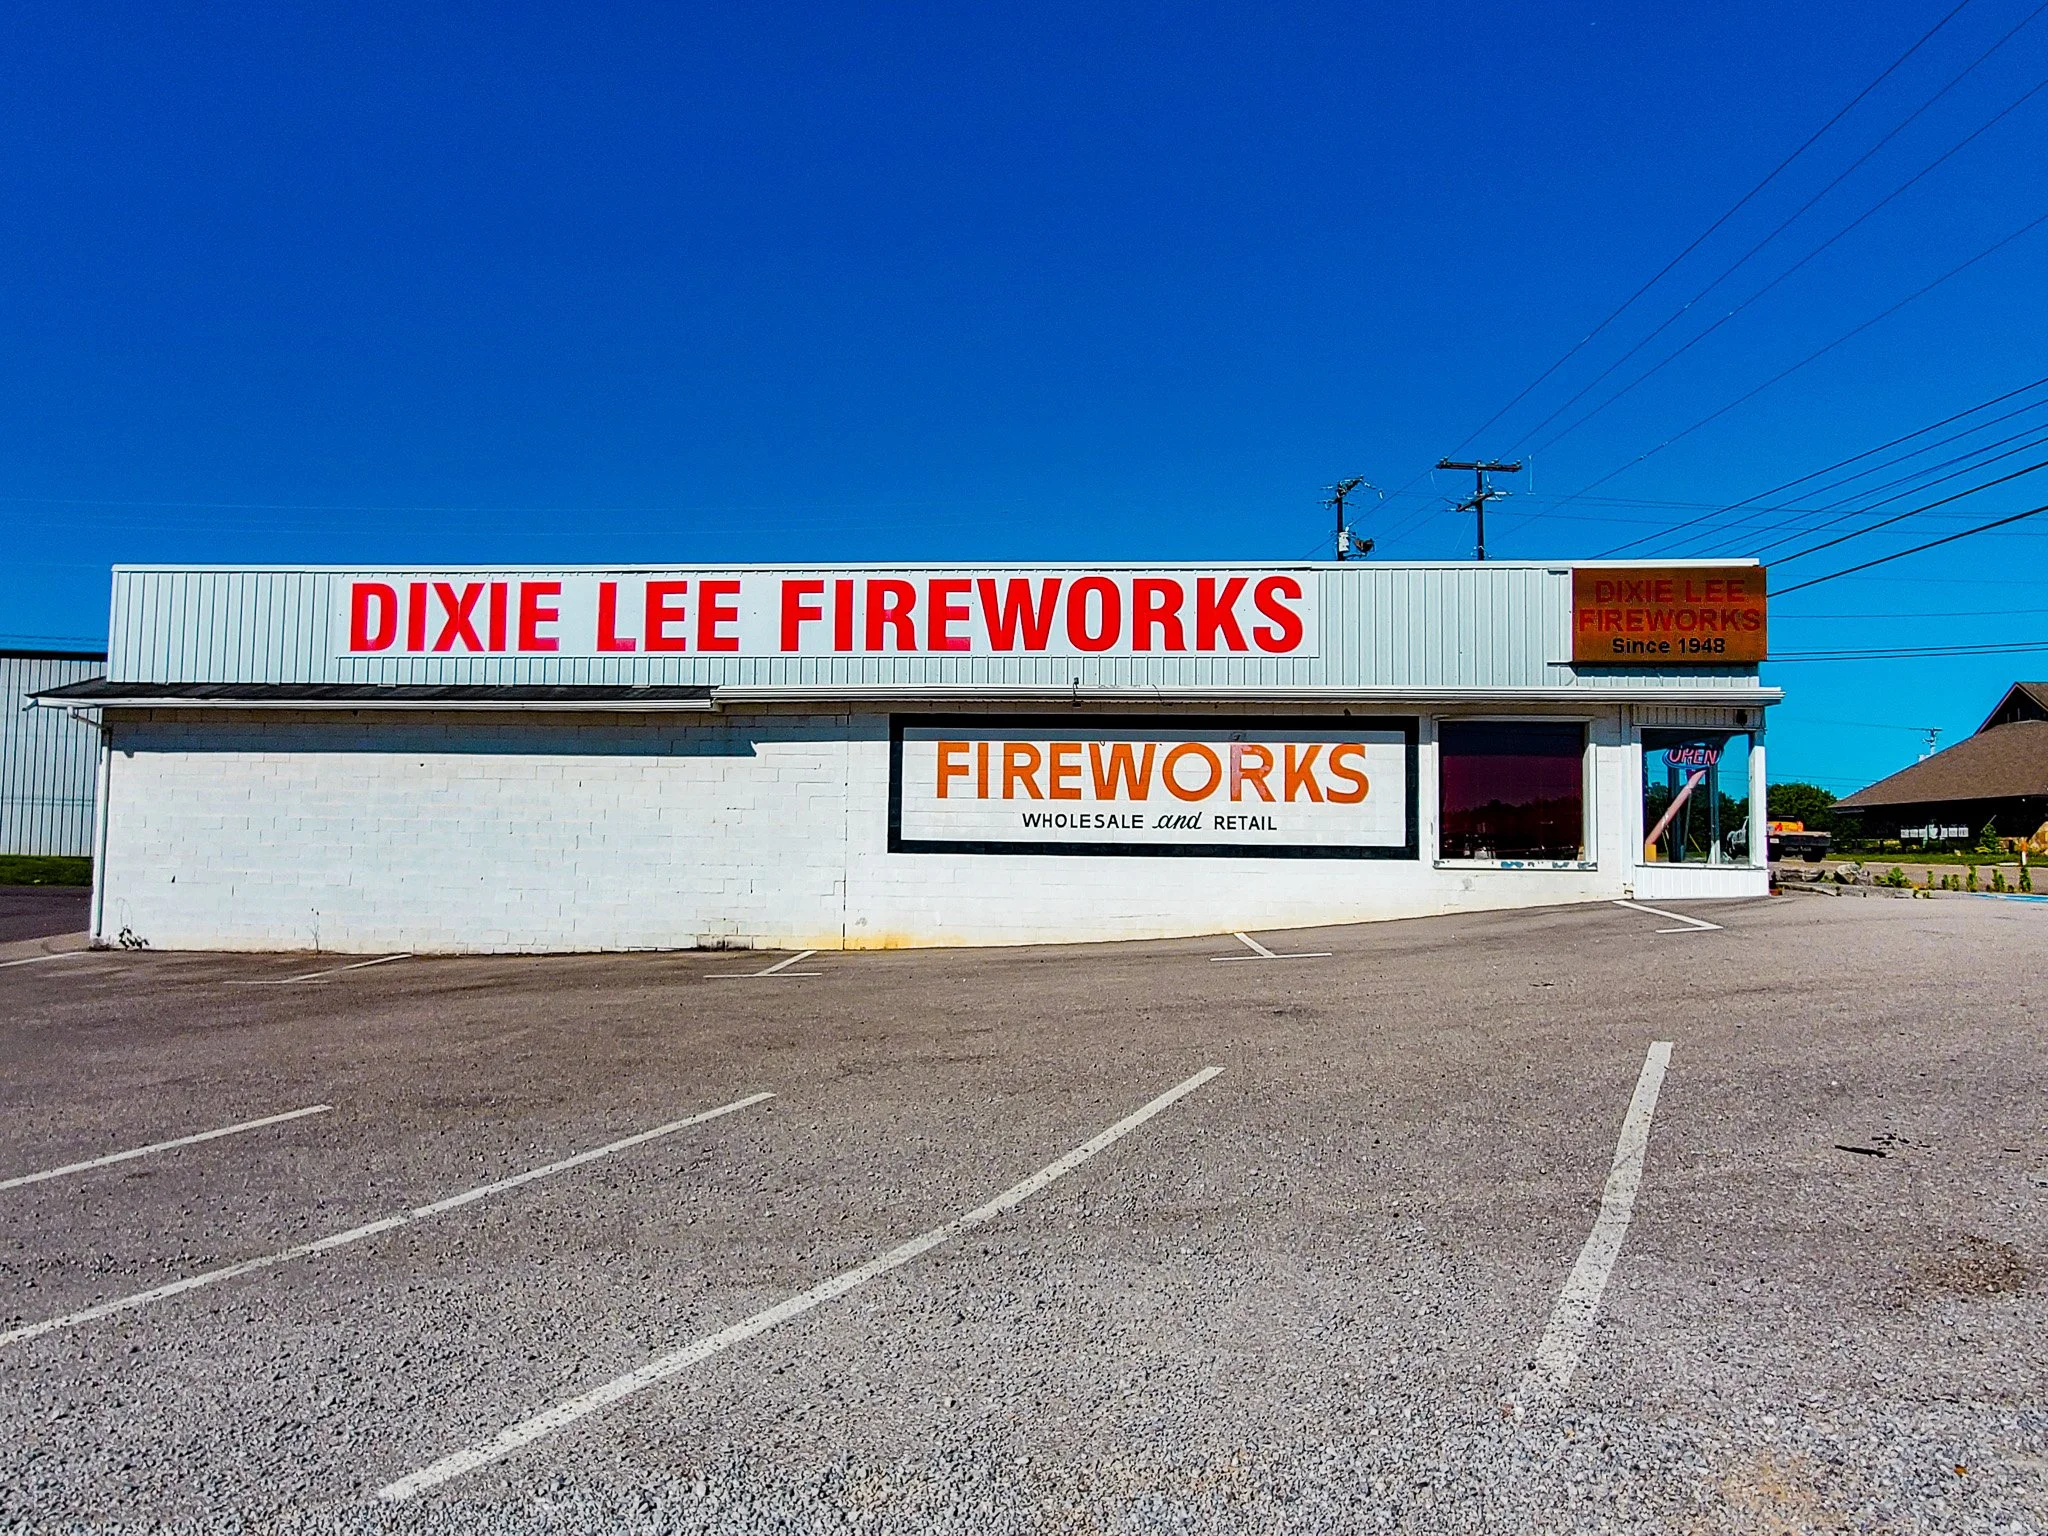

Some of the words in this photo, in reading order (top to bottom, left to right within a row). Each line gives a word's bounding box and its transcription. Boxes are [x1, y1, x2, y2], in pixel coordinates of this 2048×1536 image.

[1595, 579, 1673, 603] DIXIE
[1686, 579, 1746, 603] LEE
[350, 582, 561, 652] DIXIE
[597, 581, 740, 652] LEE
[780, 576, 1303, 654] FIREWORKS
[1579, 608, 1762, 633] FIREWORKS
[1612, 637, 1671, 654] Since
[1678, 637, 1726, 654] 1948
[1669, 748, 1718, 764] OPEN
[936, 741, 1369, 804] FIREWORKS
[1022, 813, 1144, 830] WHOLESALE
[1152, 811, 1203, 831] and
[1214, 815, 1278, 831] RETAIL
